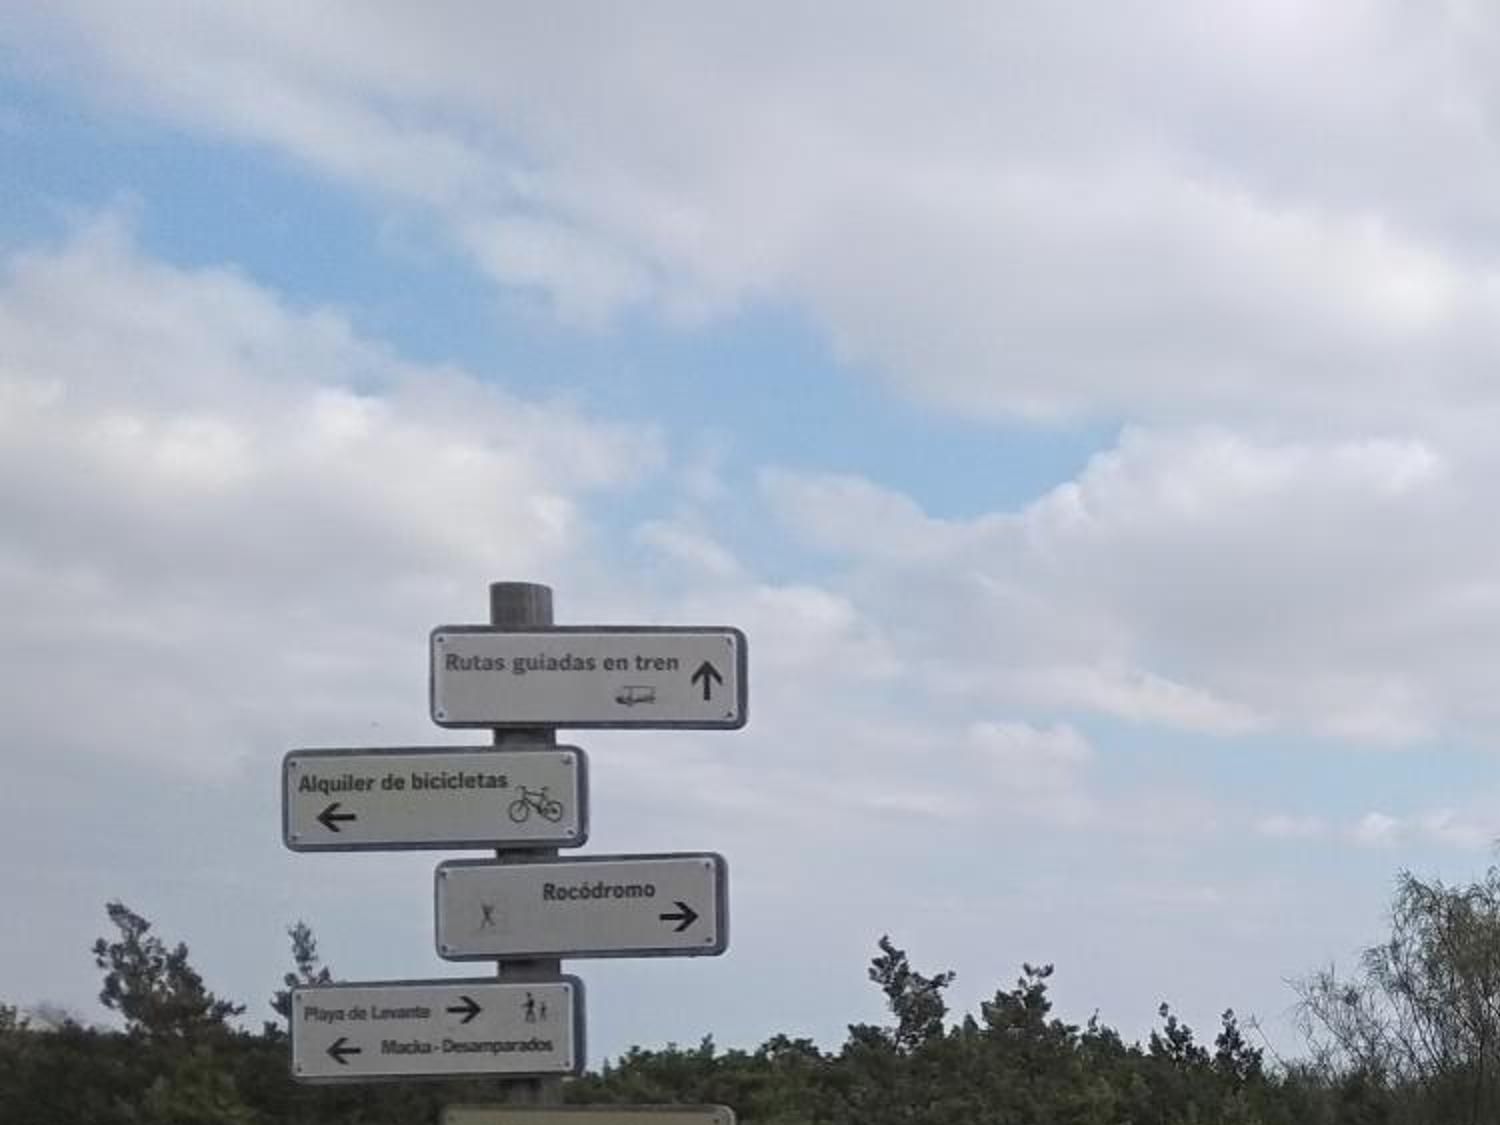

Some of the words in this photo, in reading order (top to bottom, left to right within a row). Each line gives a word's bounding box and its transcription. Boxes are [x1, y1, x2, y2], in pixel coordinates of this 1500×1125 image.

[445, 652, 505, 672] Rutas
[512, 652, 597, 676] guiadas
[602, 655, 629, 672] en
[635, 653, 680, 672] tren
[298, 773, 375, 796] Alquiler
[381, 772, 406, 791] de
[411, 771, 508, 791] bicicletas
[543, 880, 656, 901] Rocódromo
[304, 1005, 345, 1024] Playa
[348, 1004, 368, 1021] de
[371, 1004, 432, 1021] Levante
